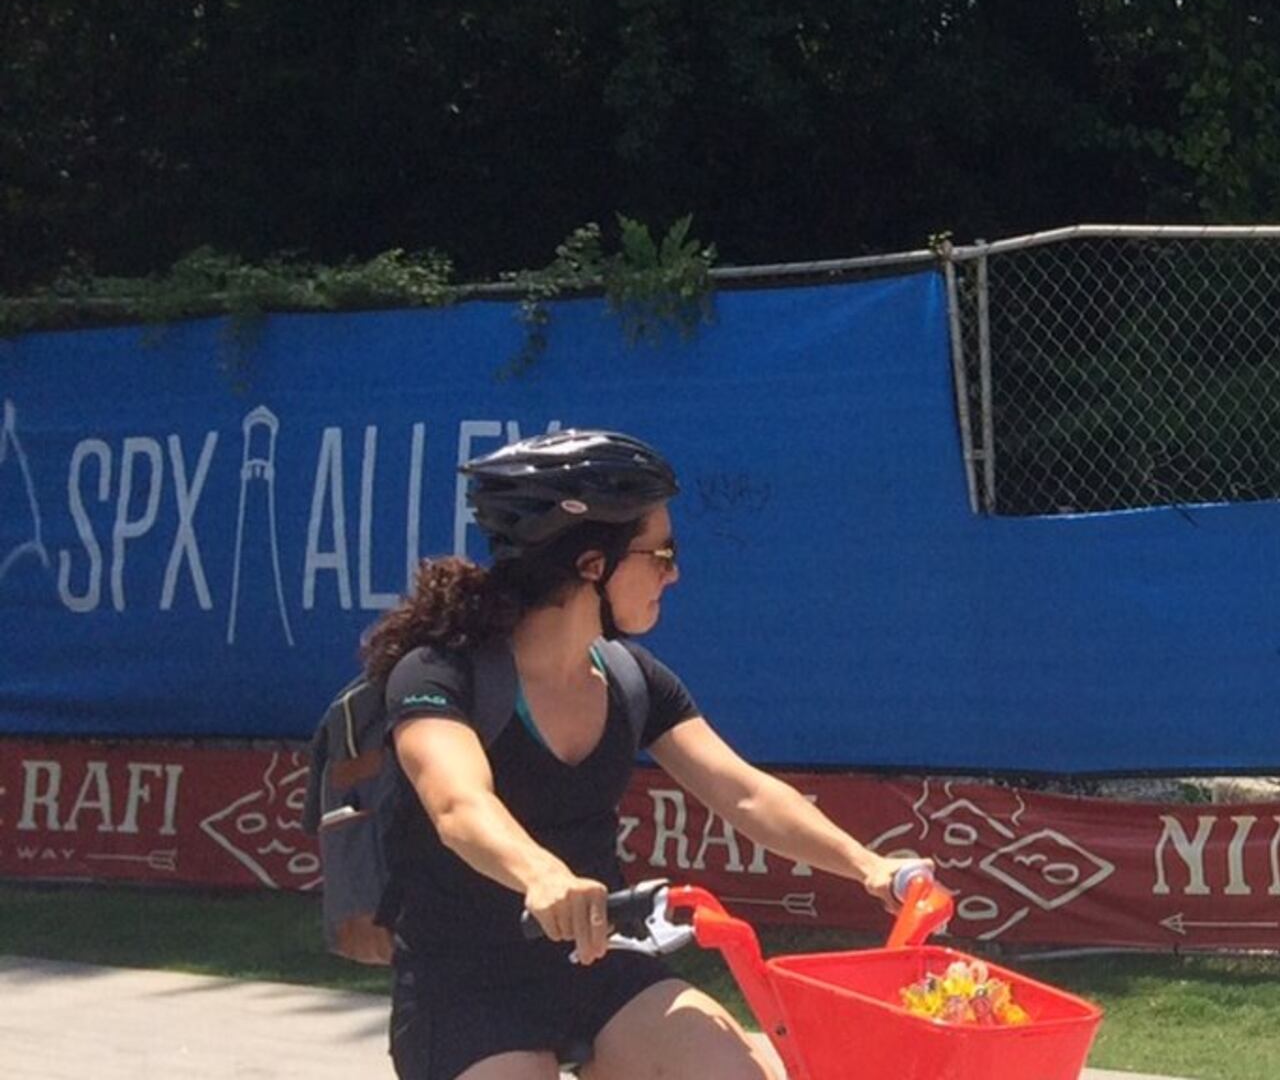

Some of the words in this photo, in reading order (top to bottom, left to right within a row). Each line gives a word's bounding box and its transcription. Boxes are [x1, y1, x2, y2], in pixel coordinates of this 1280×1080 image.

[58, 430, 218, 612] SPX
[303, 420, 561, 610] ALLE
[17, 760, 183, 835] RAFI
[17, 847, 75, 860] WAY
